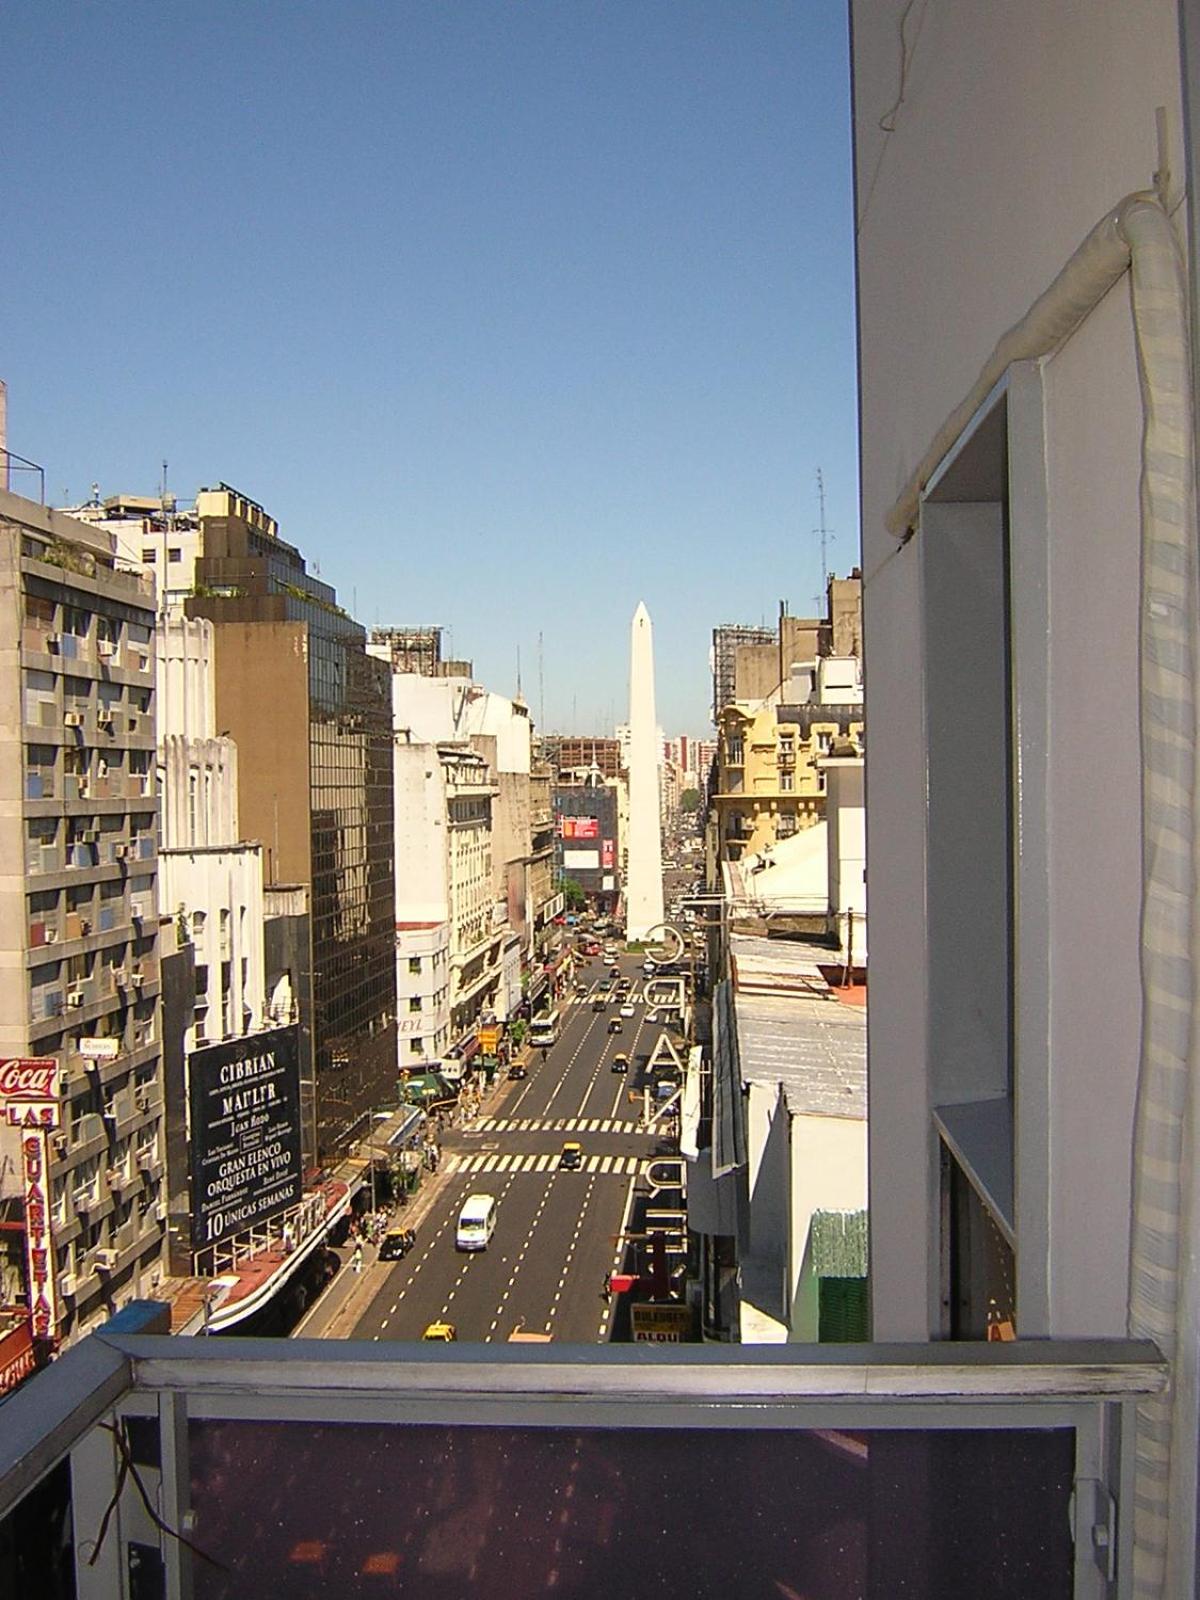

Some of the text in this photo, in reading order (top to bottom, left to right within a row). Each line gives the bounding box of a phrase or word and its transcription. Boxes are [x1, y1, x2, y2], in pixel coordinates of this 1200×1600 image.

[220, 1052, 275, 1084] CIBRIAN
[9, 1107, 54, 1129] LAS
[207, 1167, 256, 1197] ORQUESTA
[258, 1162, 269, 1176] EN
[271, 1151, 291, 1170] VIVO
[219, 1155, 246, 1178] GRAN
[248, 1141, 281, 1168] ELENCO
[207, 1213, 223, 1241] 10
[258, 1184, 294, 1212] SEMANAS
[26, 1136, 51, 1338] CUARTETAS
